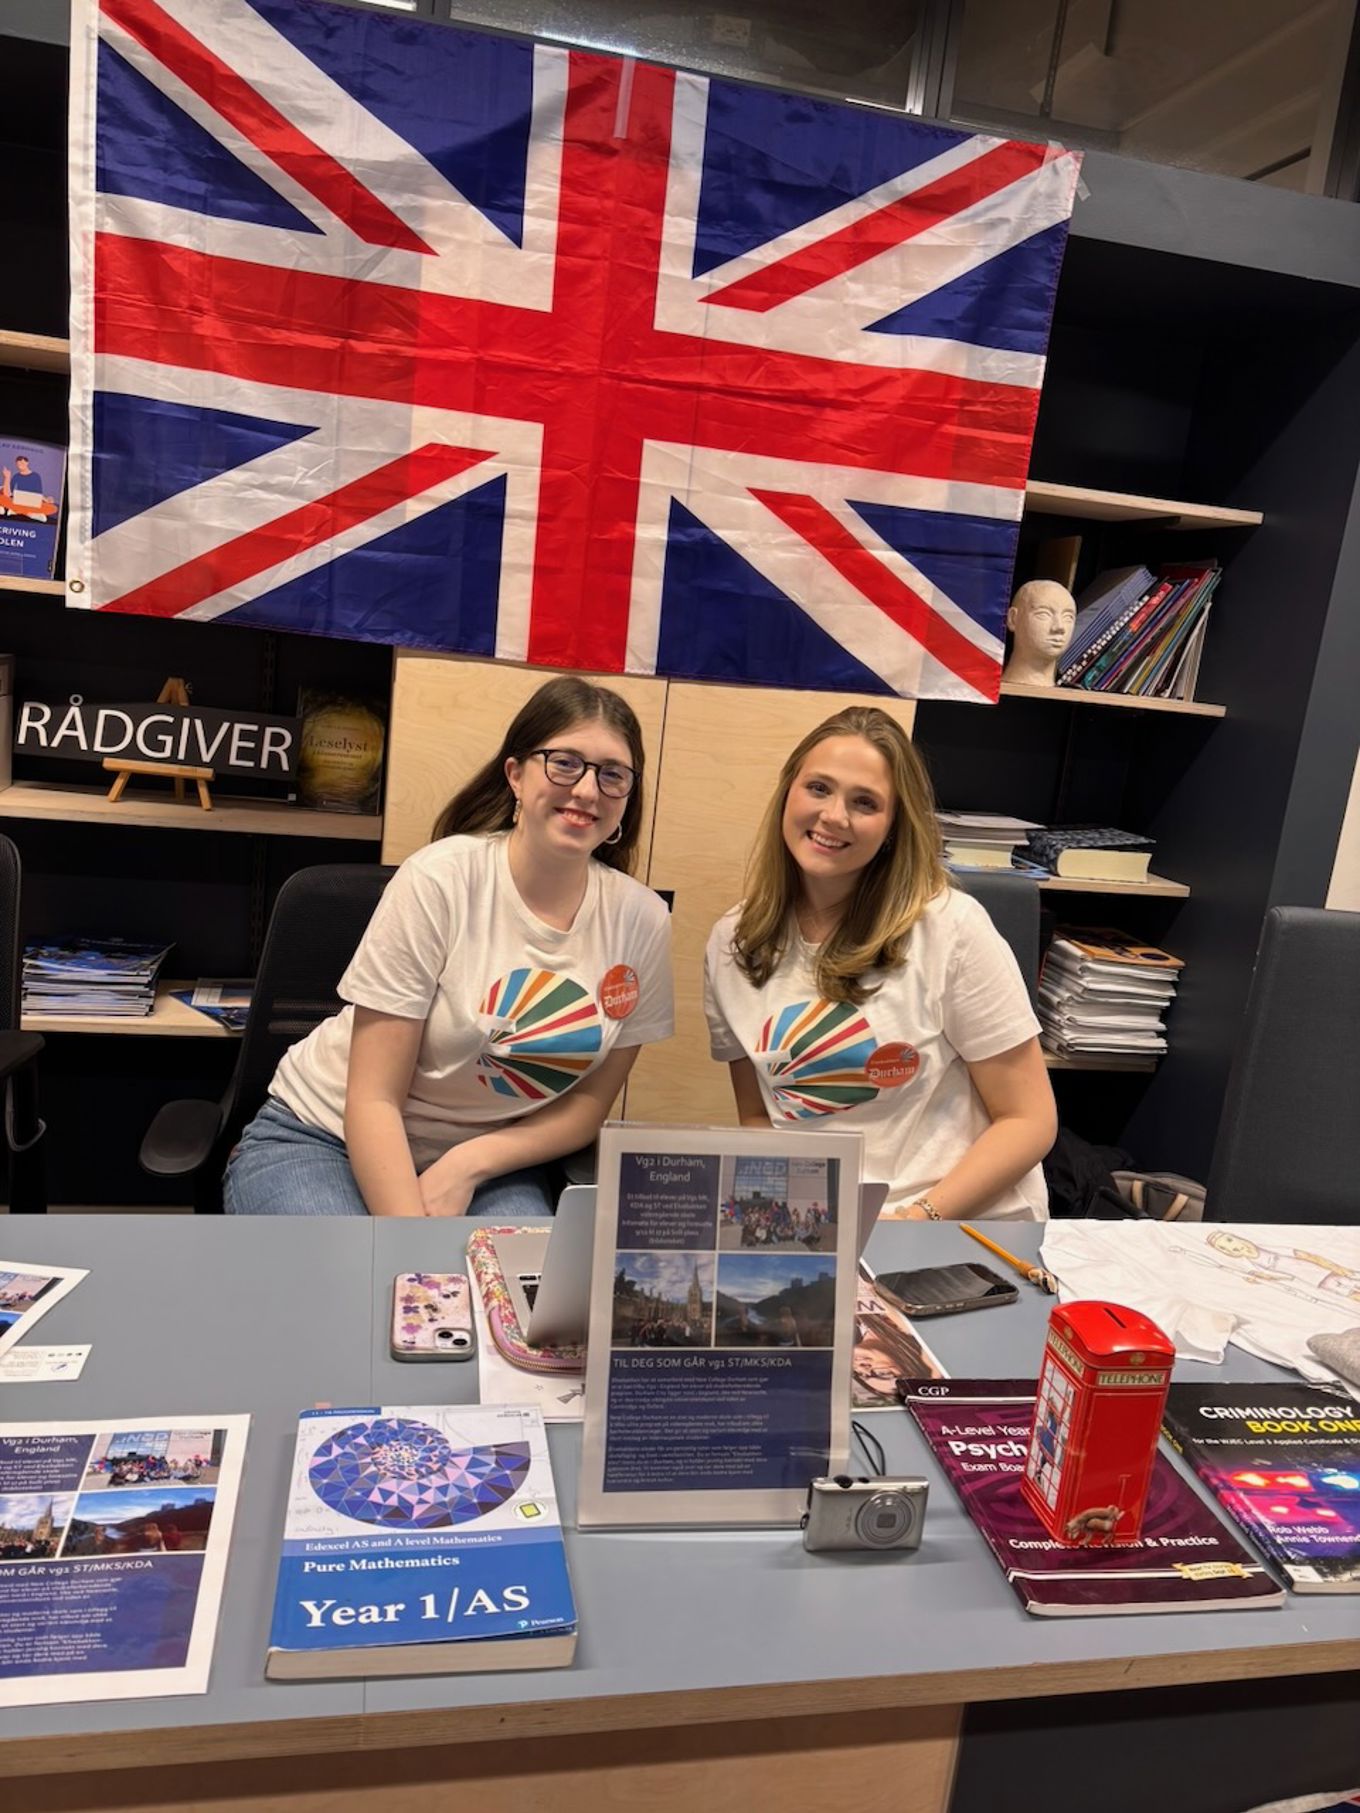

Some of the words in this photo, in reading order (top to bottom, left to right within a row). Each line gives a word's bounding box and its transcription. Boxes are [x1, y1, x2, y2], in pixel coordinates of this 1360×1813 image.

[17, 694, 293, 771] RÅDGIVER
[309, 736, 368, 753] Leselyst
[635, 1156, 654, 1169] Vg2
[662, 1156, 706, 1168] Durham,
[649, 1171, 691, 1185] England
[613, 1358, 629, 1368] TIL
[631, 1358, 653, 1368] DEG
[656, 1358, 681, 1368] SOM
[683, 1356, 706, 1368] GÅR
[727, 1357, 793, 1368] ST/MKS/KDA
[1099, 1373, 1164, 1384] TELEPHONE
[918, 1386, 950, 1396] CGP
[1199, 1406, 1354, 1420] CRIMINOLOGY
[941, 1425, 995, 1436] A-Level
[996, 1426, 1031, 1436] Year
[1246, 1420, 1318, 1434] BOOK
[2, 1438, 23, 1447] Vg2
[31, 1436, 79, 1444] Durham,
[14, 1445, 61, 1455] England
[961, 1462, 997, 1472] Exam
[1292, 1526, 1329, 1534] Webb
[305, 1541, 350, 1551] Edexcel
[351, 1540, 369, 1550] AS
[371, 1538, 392, 1548] and
[394, 1538, 404, 1547] A
[405, 1536, 431, 1546] level
[432, 1534, 503, 1545] Mathematics
[1009, 1538, 1079, 1551] Comple
[1144, 1537, 1160, 1547] &
[1158, 1536, 1219, 1547] Practice
[0, 1568, 15, 1577] M
[18, 1565, 46, 1577] GÅR
[73, 1560, 154, 1573] ST/MKS/KDA
[303, 1561, 345, 1573] Pure
[349, 1555, 460, 1571] Mathematics
[300, 1599, 406, 1628] Year
[420, 1585, 530, 1622] 1/AS
[531, 1616, 564, 1627] Pearson
